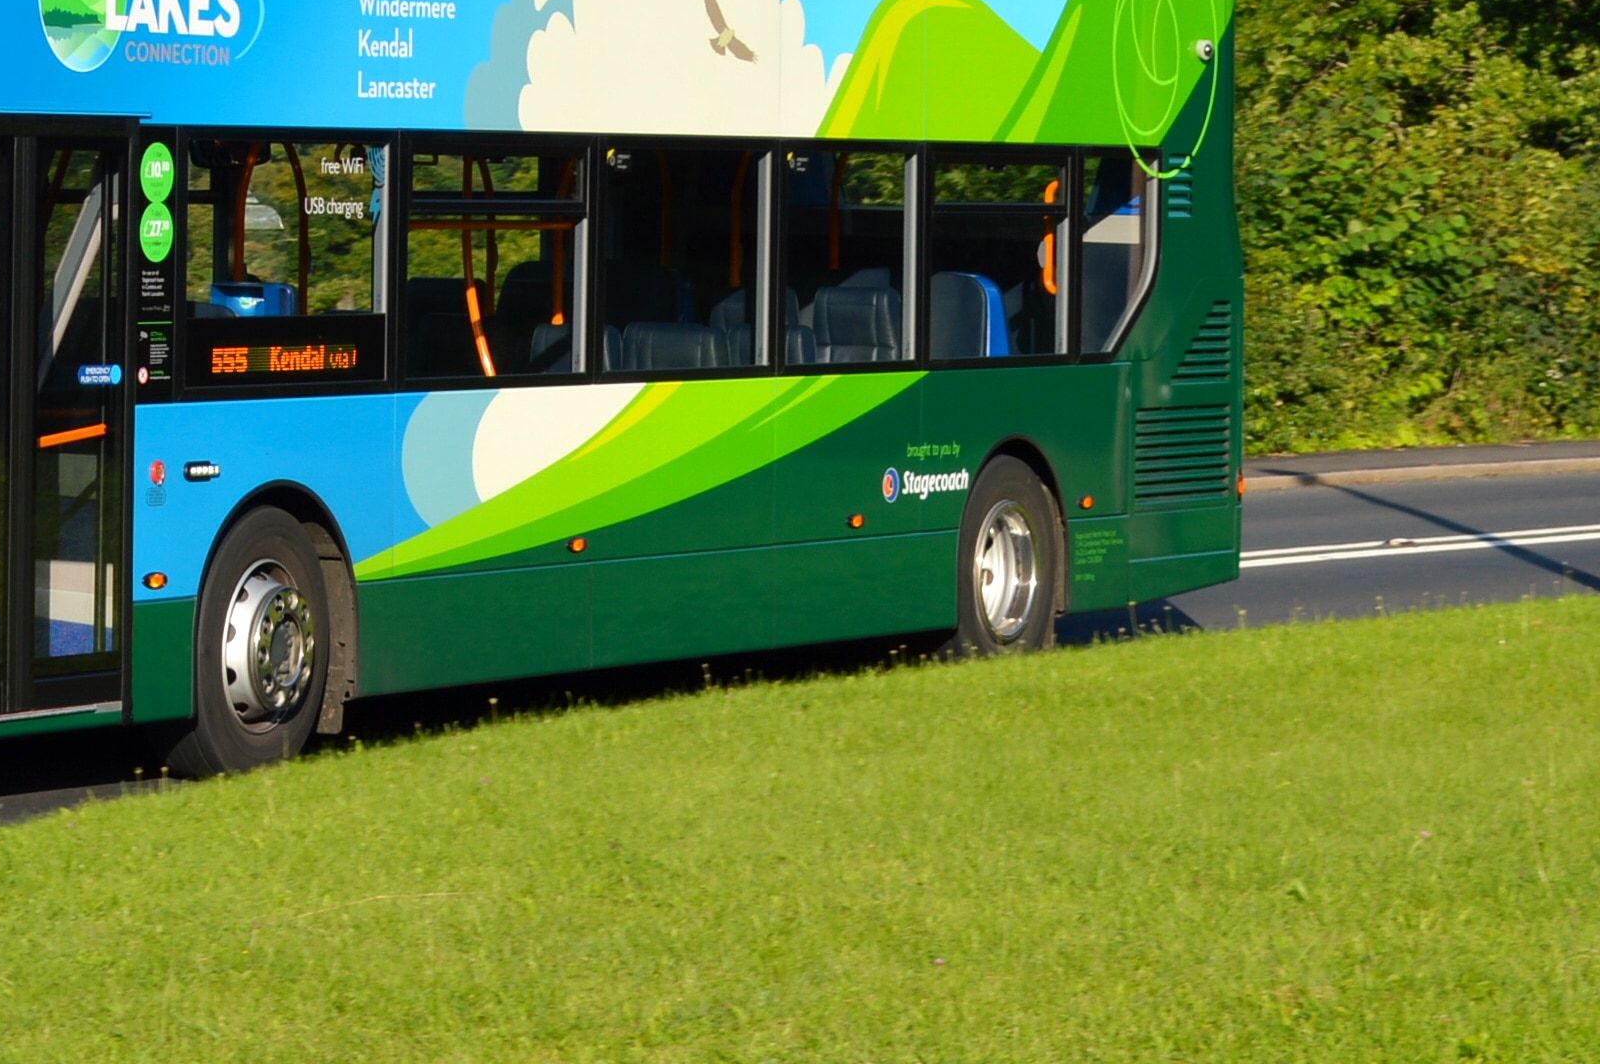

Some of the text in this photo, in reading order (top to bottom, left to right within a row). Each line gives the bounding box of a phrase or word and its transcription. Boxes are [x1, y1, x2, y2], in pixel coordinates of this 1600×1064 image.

[125, 40, 230, 66] CONNECTION
[357, 27, 414, 58] Kendal
[357, 70, 436, 99] Lancaster
[321, 157, 364, 174] free WiFi
[304, 196, 364, 220] USB charging
[212, 347, 248, 373] 555
[270, 345, 325, 371] Kendal
[329, 347, 349, 369] via
[906, 440, 961, 461] brought to you by
[902, 468, 969, 500] Stagecoach
